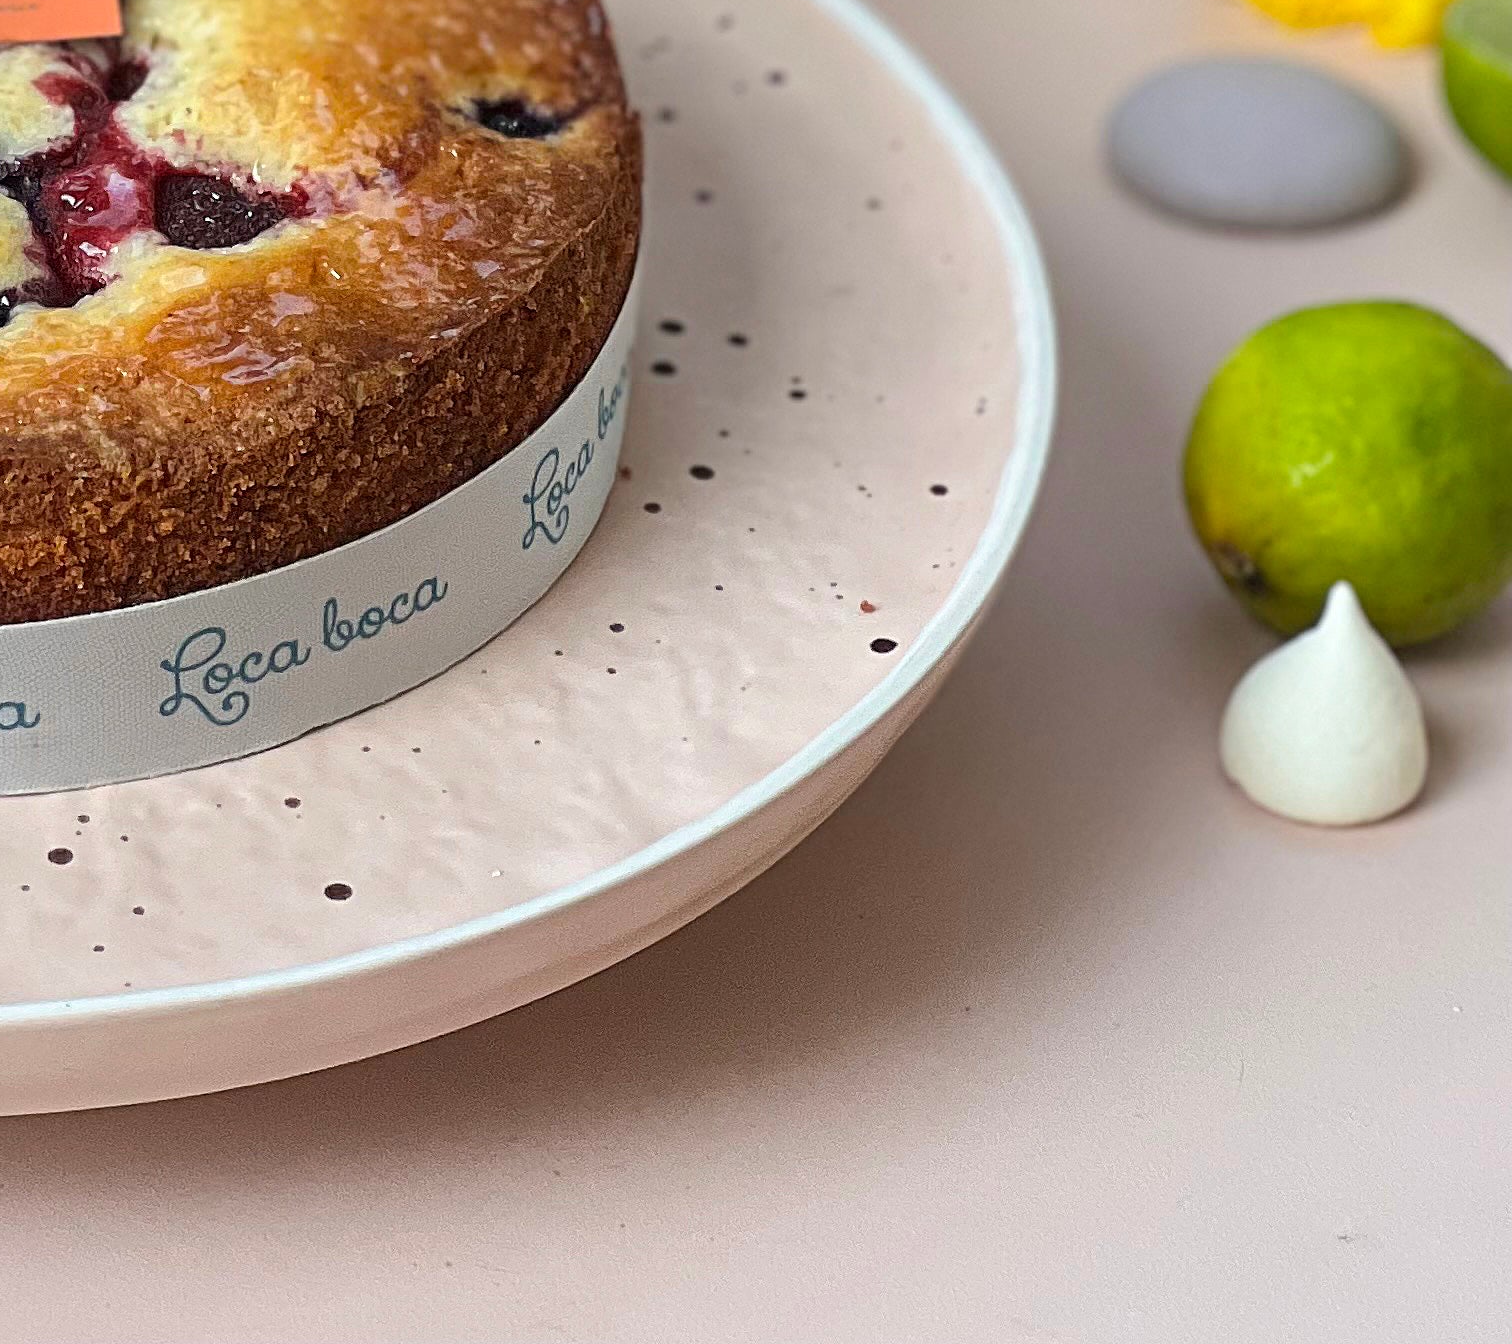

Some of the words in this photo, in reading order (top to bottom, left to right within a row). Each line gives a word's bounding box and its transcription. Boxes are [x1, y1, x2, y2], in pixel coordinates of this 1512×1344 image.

[522, 443, 594, 549] Loca
[159, 627, 310, 726] Loca
[322, 574, 450, 652] boca
